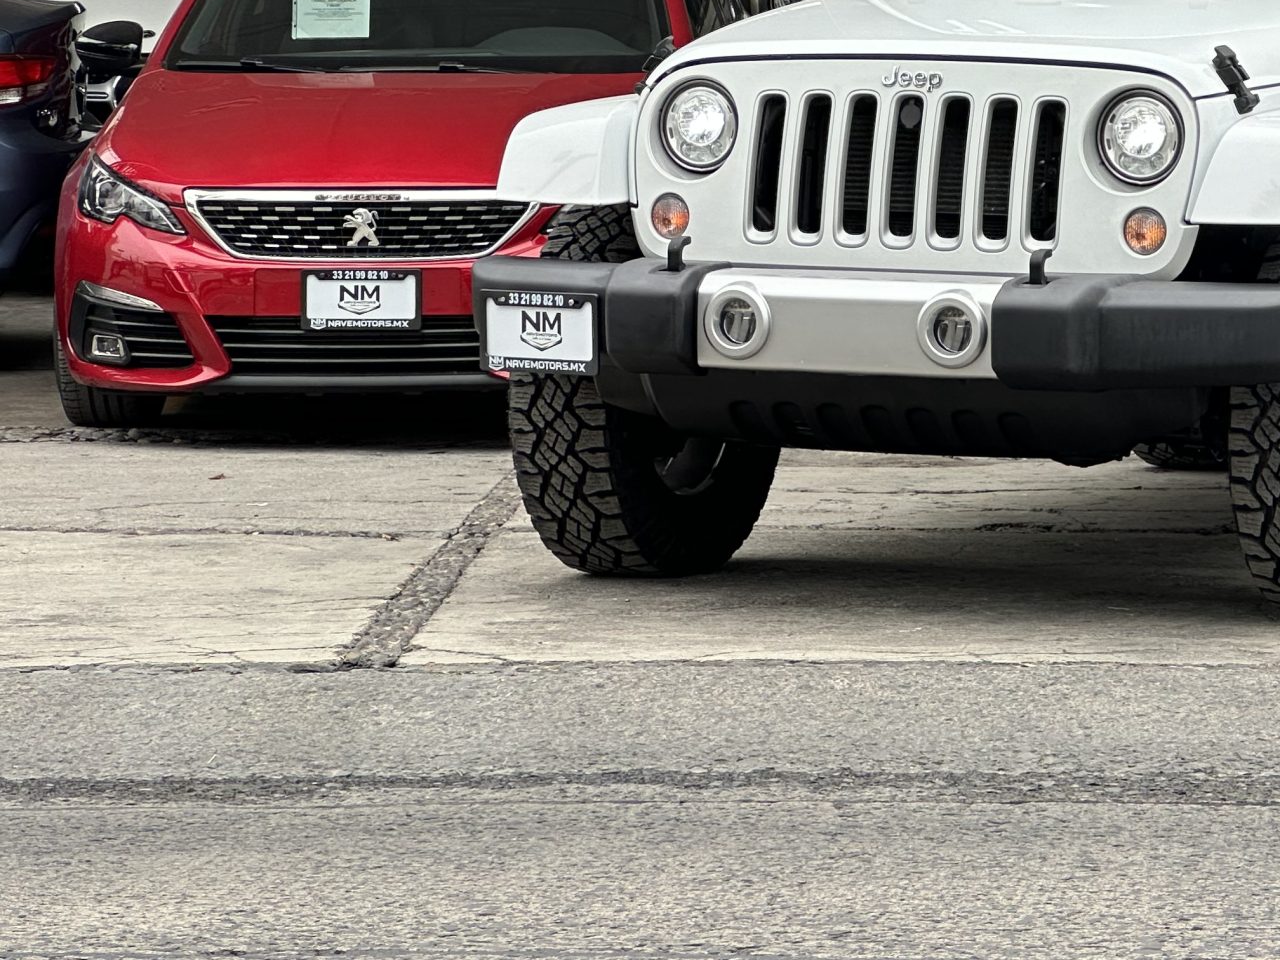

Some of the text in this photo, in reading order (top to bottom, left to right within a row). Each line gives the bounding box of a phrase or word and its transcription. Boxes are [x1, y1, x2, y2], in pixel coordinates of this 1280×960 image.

[881, 64, 943, 92] Jeep
[332, 270, 389, 280] 33 21 99 82 10
[339, 284, 381, 302] NM
[508, 293, 564, 306] 33 21 99 82 10
[327, 320, 410, 328] NAVEMOTORS.MX
[521, 310, 562, 336] NM
[505, 359, 586, 372] NAVEMOTORS.MX
